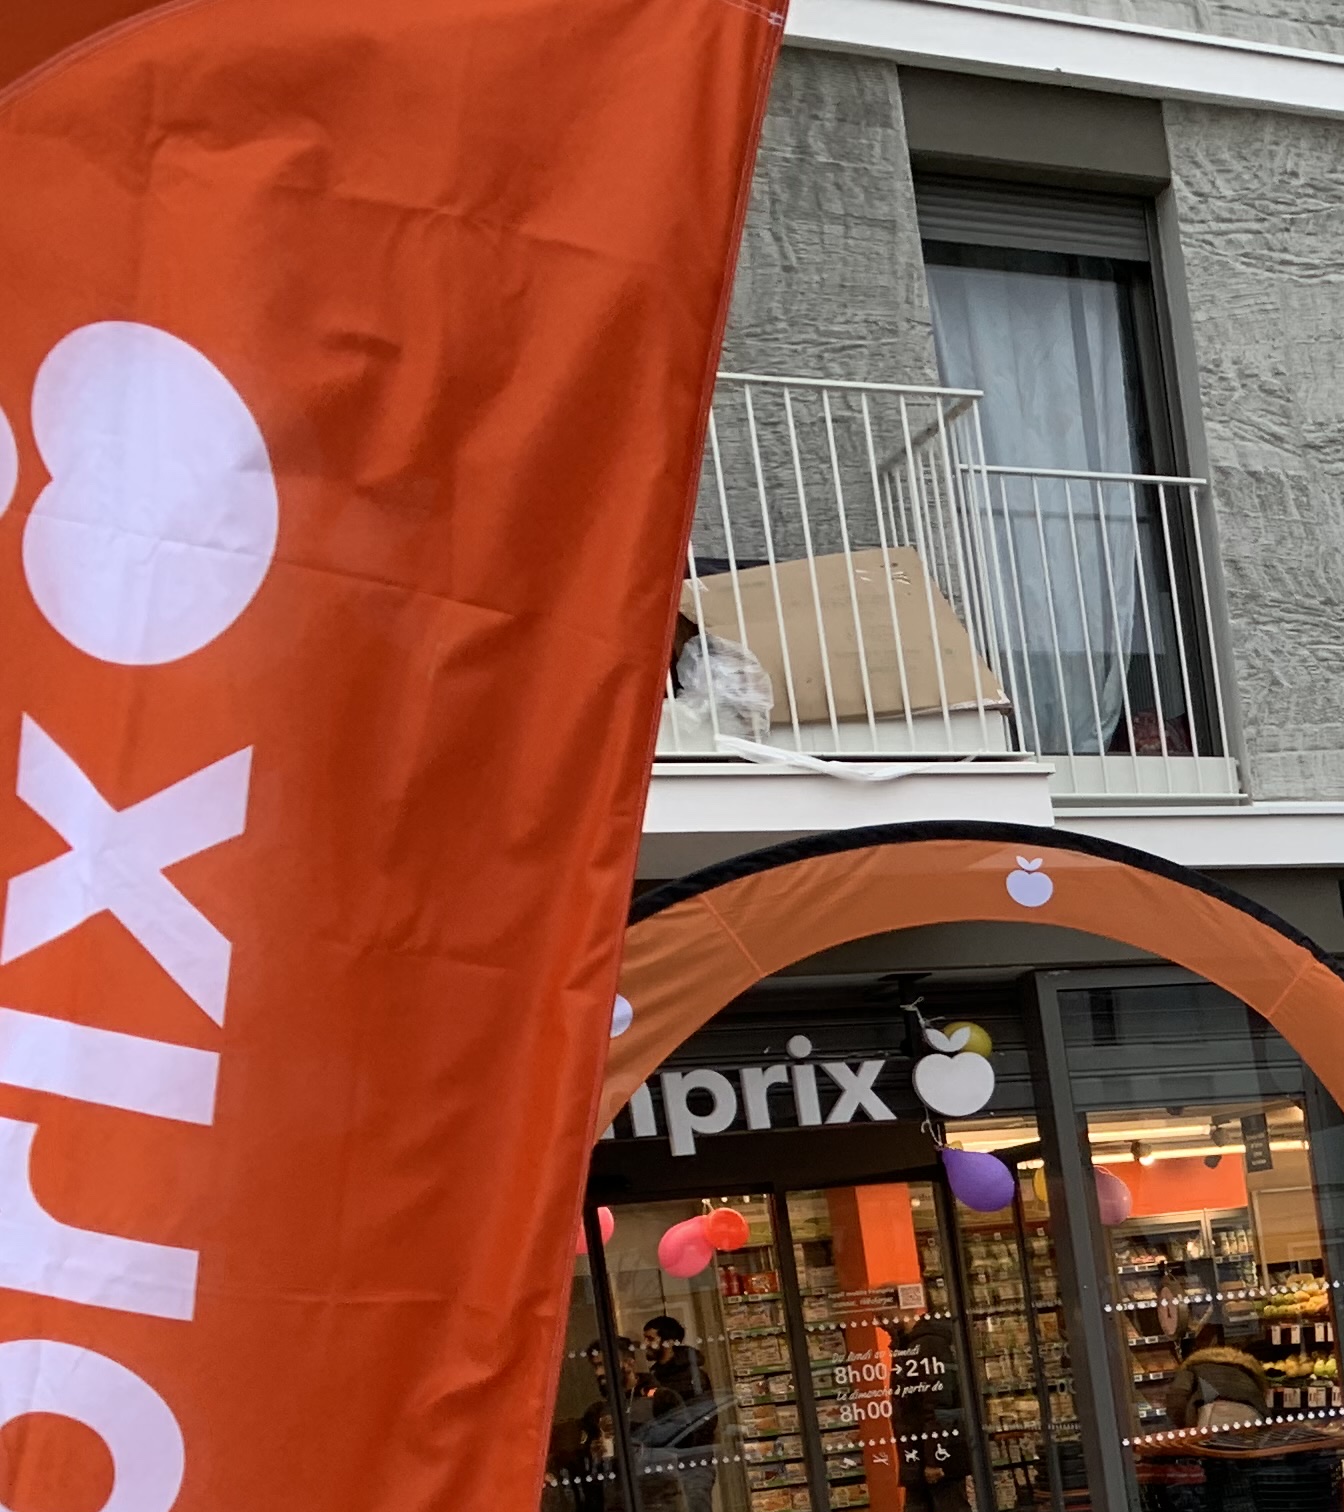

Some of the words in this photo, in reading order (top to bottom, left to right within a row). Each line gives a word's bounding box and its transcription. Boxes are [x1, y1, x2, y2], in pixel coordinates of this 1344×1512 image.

[905, 1356, 946, 1377] 21h
[901, 1381, 931, 1398] partir
[931, 1380, 944, 1391] de
[840, 1400, 893, 1423] 8h00
